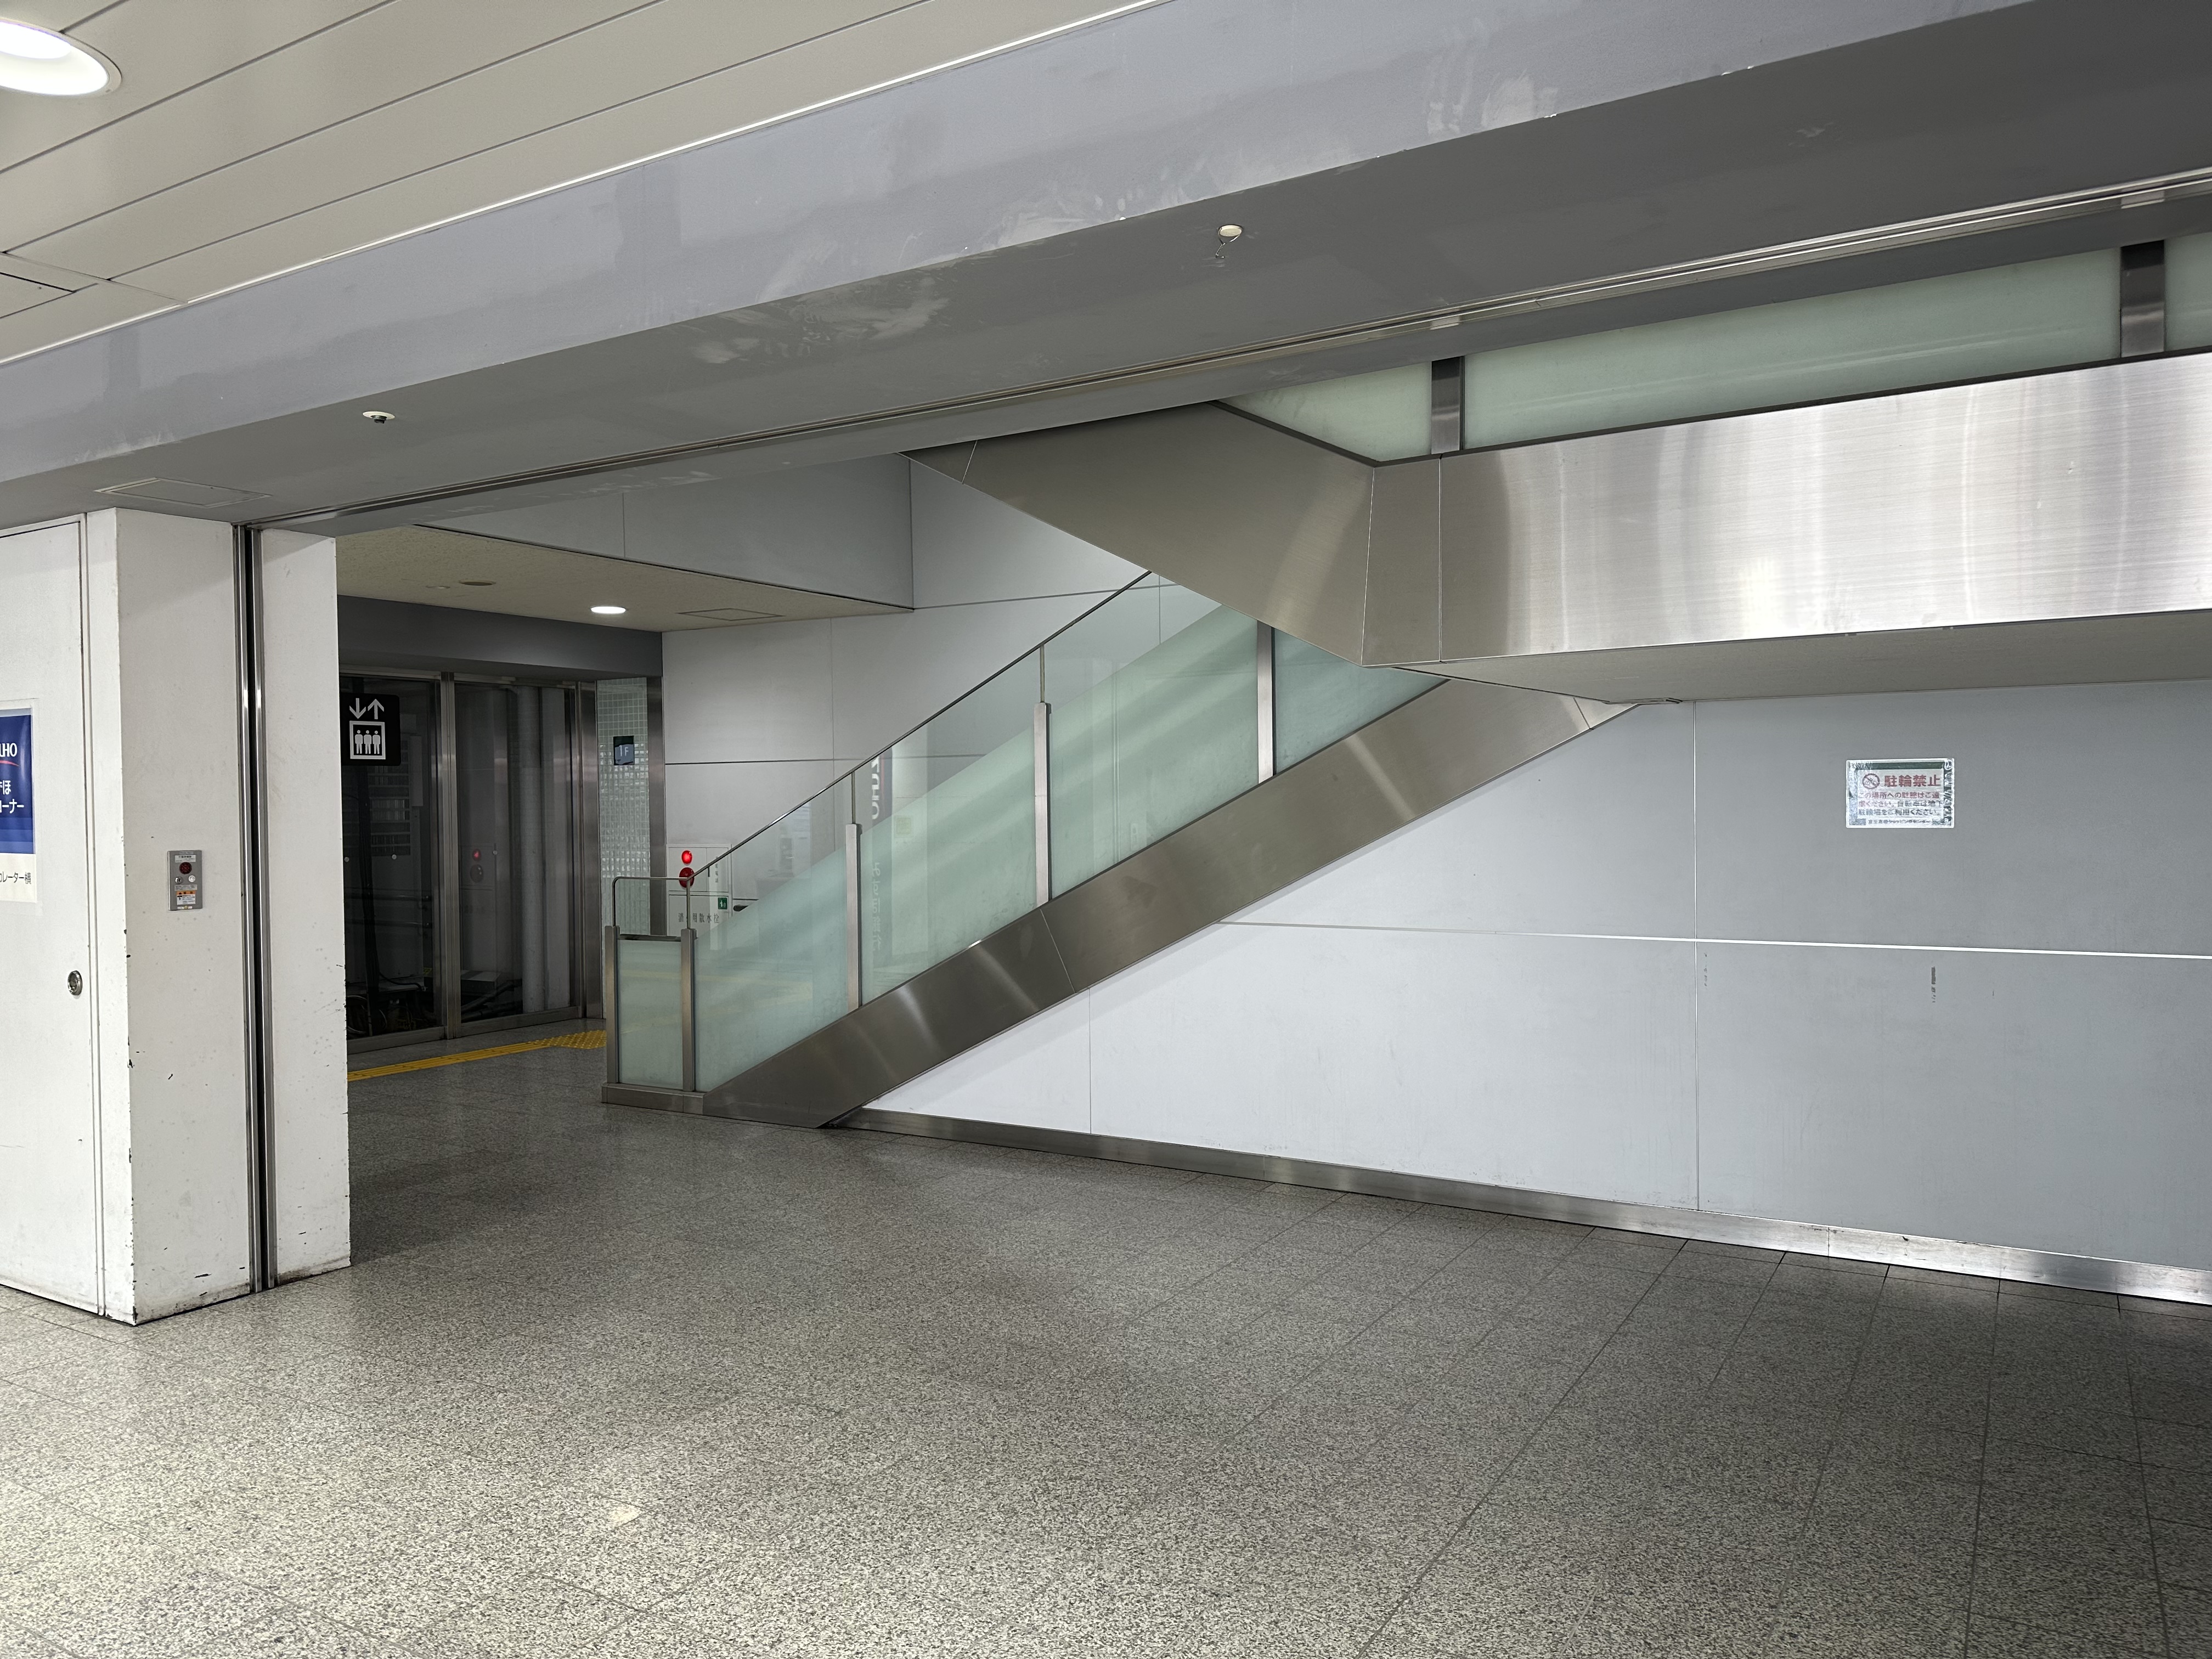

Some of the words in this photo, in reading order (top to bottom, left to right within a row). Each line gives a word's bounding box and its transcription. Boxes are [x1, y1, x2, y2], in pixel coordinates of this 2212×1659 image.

[619, 744, 629, 757] 1F
[1884, 774, 1941, 787] 駐輪禁止
[678, 912, 719, 923] 消用散水栓
